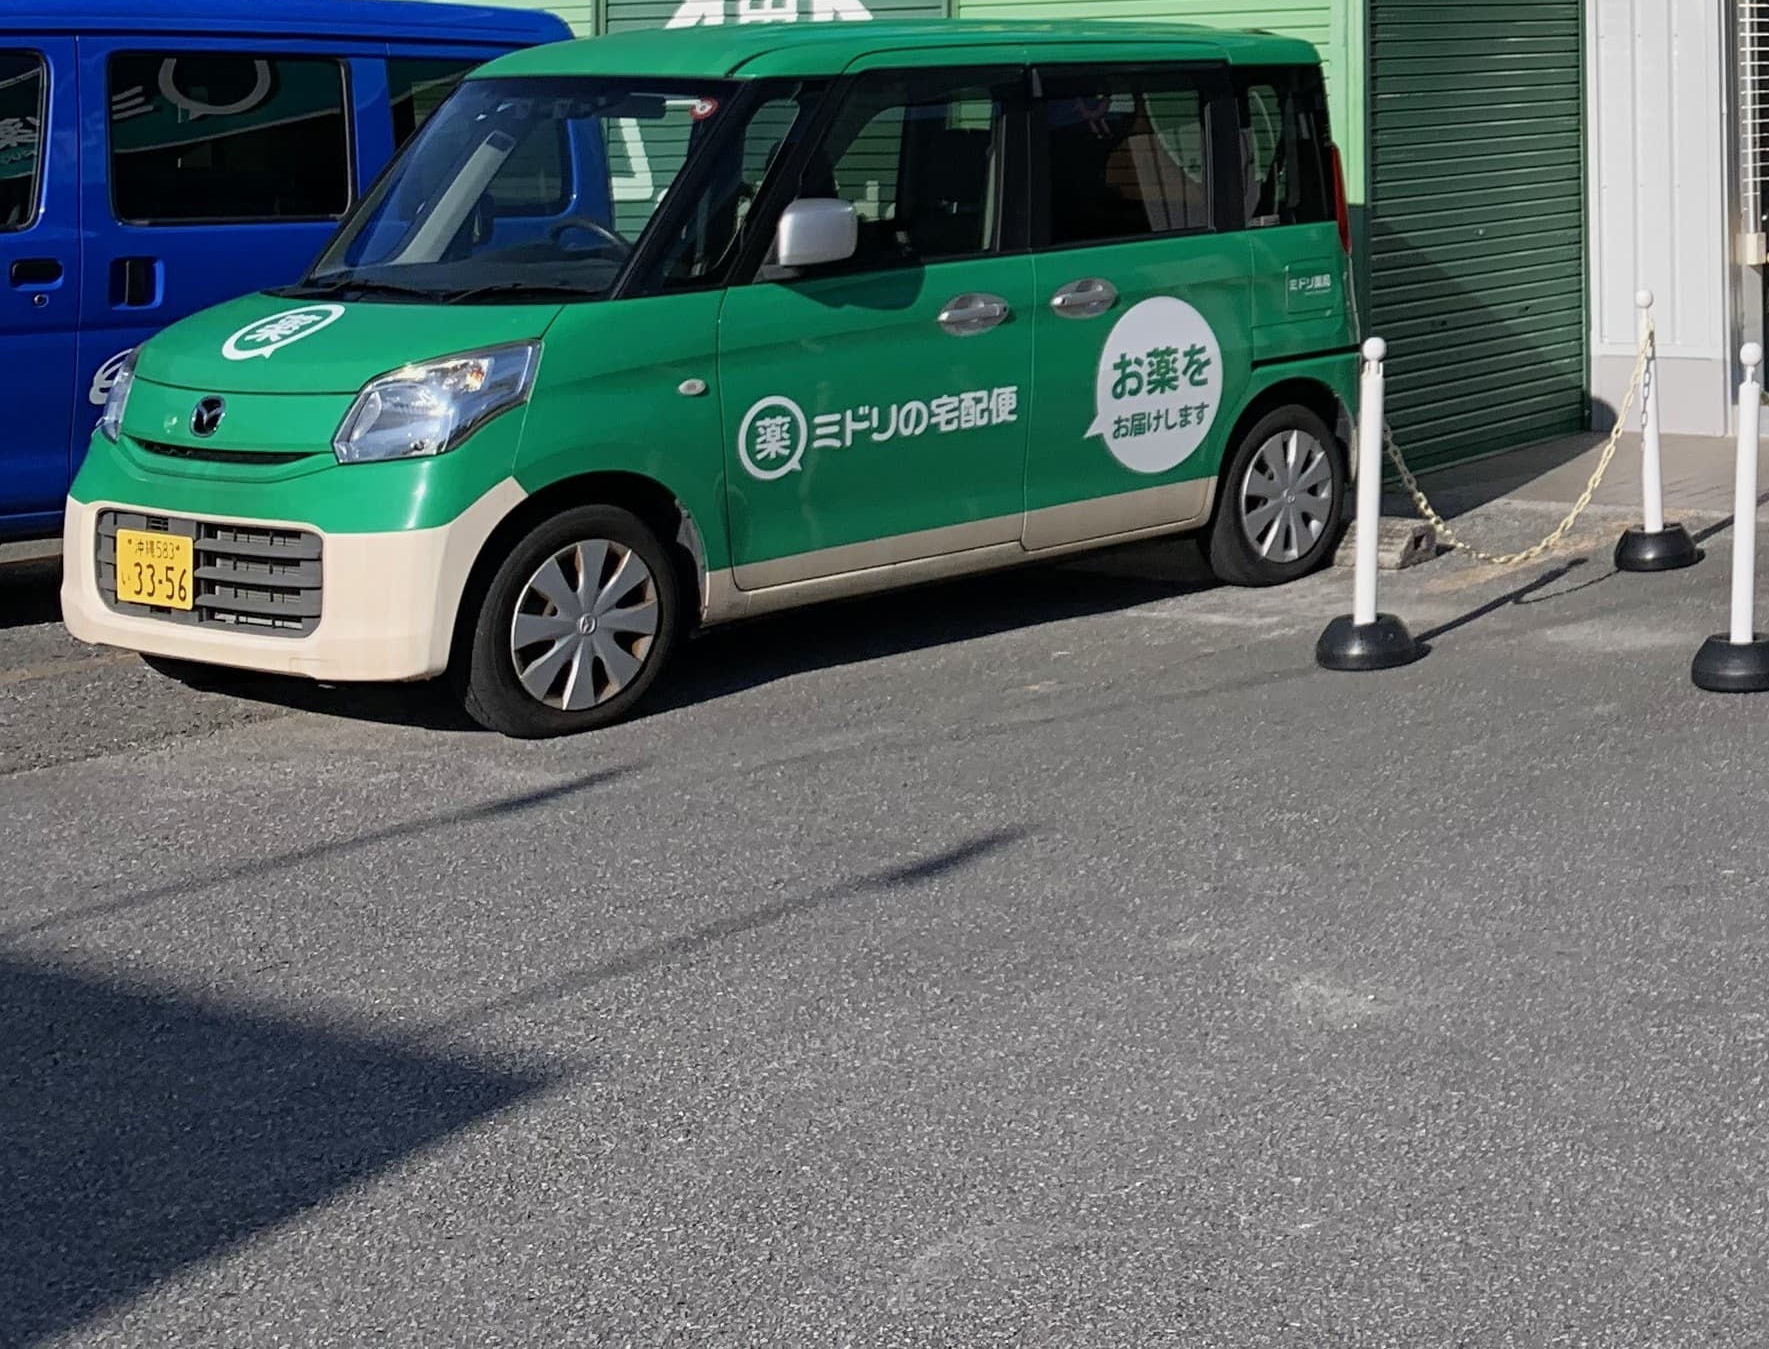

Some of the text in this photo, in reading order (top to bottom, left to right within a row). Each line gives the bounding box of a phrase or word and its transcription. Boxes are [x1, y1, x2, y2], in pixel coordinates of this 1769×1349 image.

[1111, 343, 1213, 400] お薬を
[755, 385, 1018, 461] 薬 ミドリの宅配便
[1112, 402, 1210, 440] お届けします
